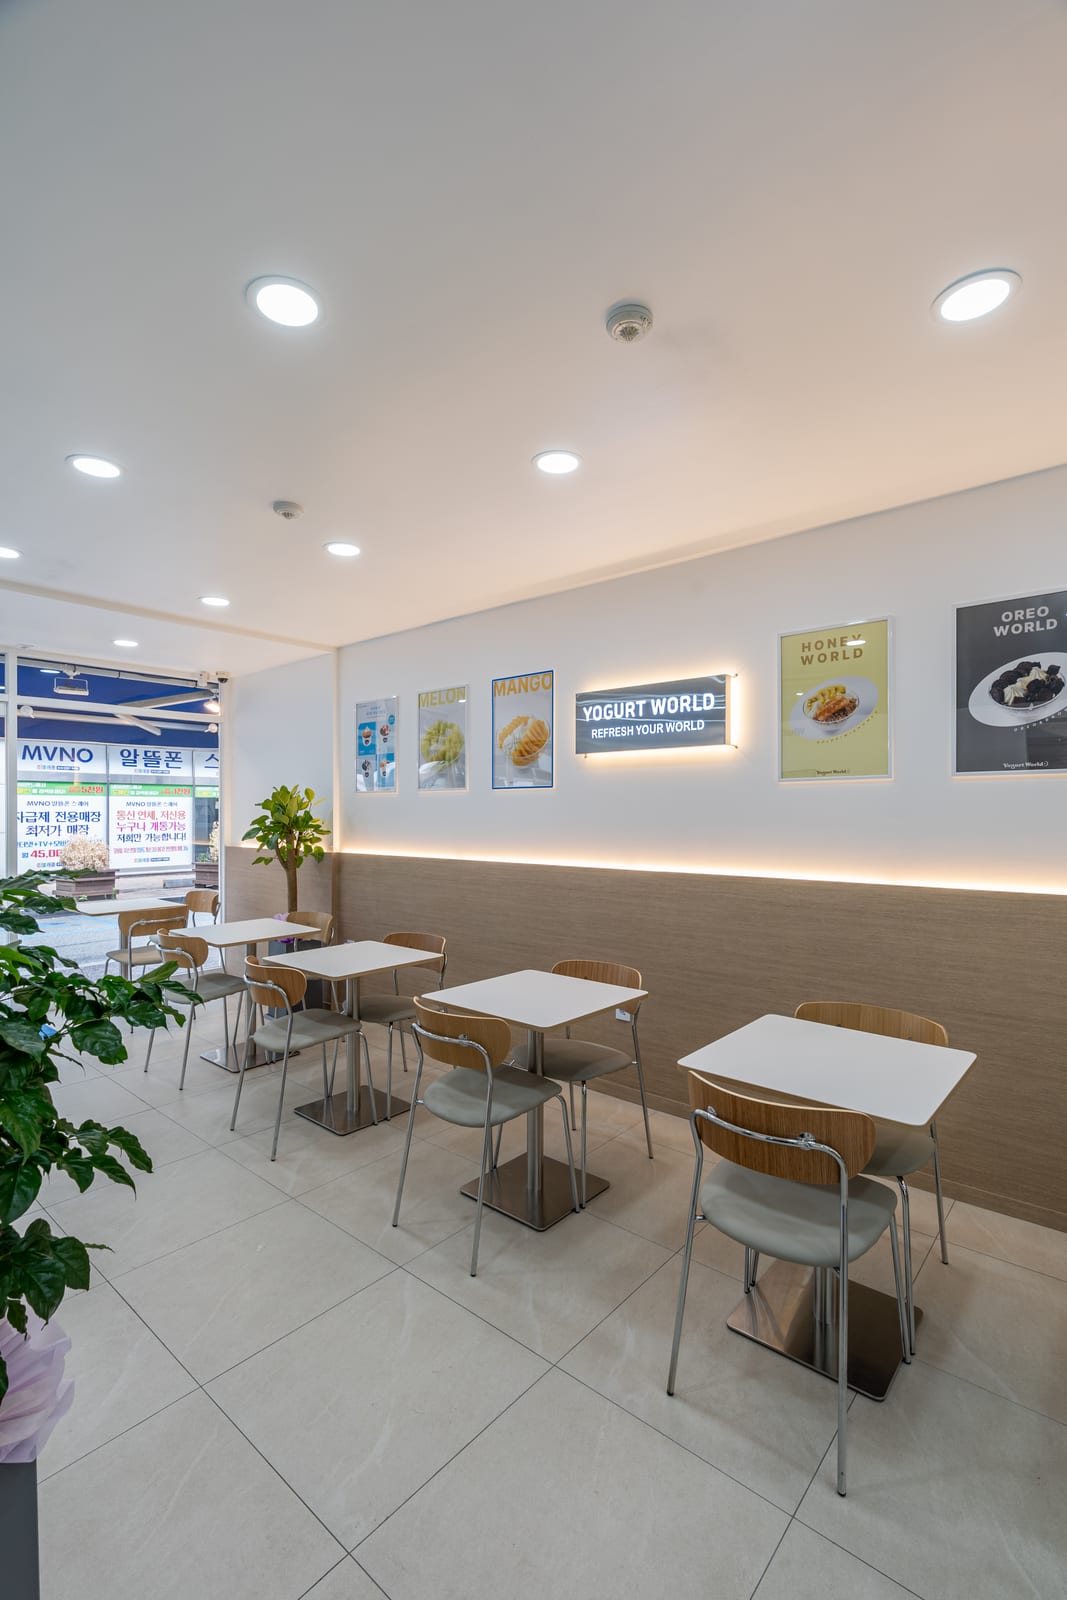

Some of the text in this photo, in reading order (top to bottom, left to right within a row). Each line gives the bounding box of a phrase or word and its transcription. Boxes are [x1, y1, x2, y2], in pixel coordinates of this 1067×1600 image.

[1001, 606, 1049, 622] OREO
[993, 618, 1058, 637] WORLD
[800, 647, 863, 666] WORLD
[494, 673, 552, 697] MANGO
[418, 687, 466, 708] MELON
[583, 693, 715, 721] YOGURT WORLD
[591, 719, 705, 739] REFRESH YOUR WORLD
[22, 745, 93, 763] MVNO
[120, 749, 183, 769] 알뜰폰
[55, 811, 101, 823] 전용매장
[116, 810, 135, 820] 통신
[160, 810, 186, 820] 저신용
[25, 825, 62, 837] 최저가
[116, 821, 186, 832] 누구나 개통가능
[116, 833, 141, 843] 저희만
